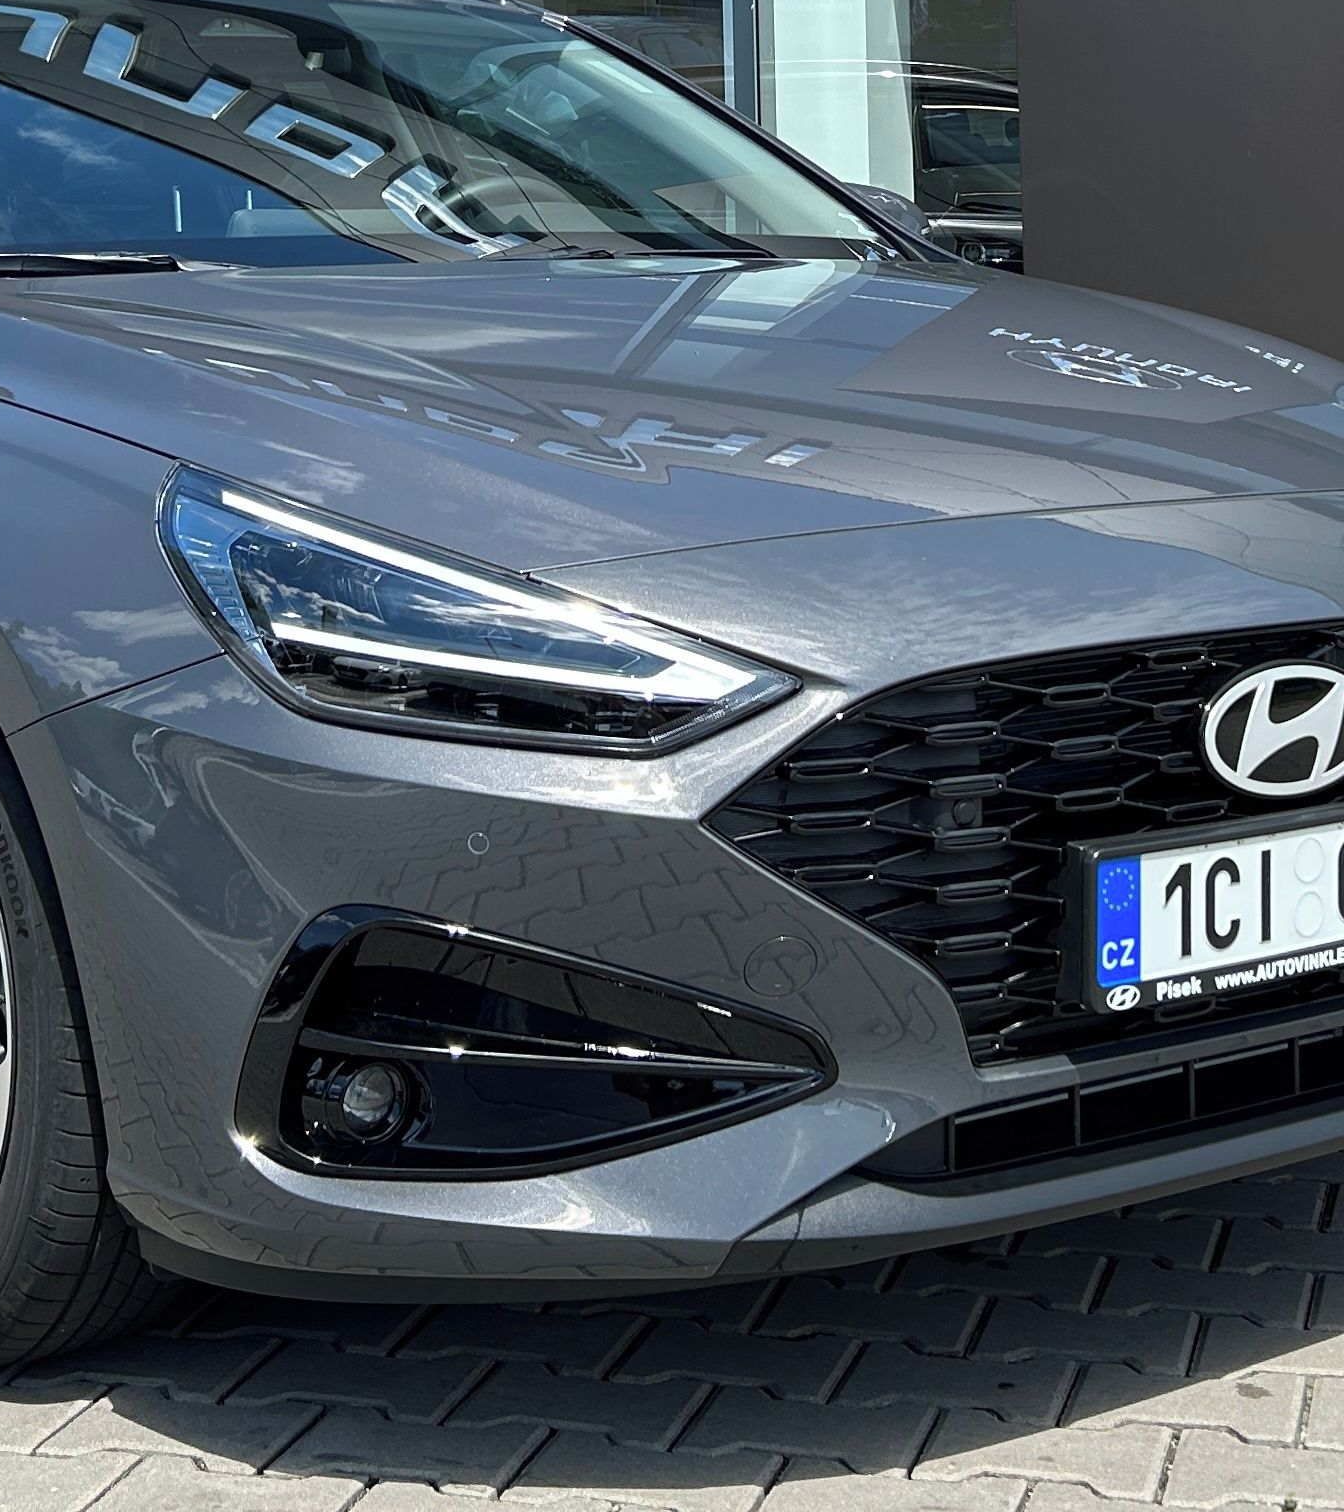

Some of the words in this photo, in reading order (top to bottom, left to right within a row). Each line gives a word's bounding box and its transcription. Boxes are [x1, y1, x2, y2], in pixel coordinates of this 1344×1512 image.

[1164, 849, 1272, 960] 1CI
[1101, 938, 1136, 971] CZ
[1156, 977, 1202, 1002] Písek
